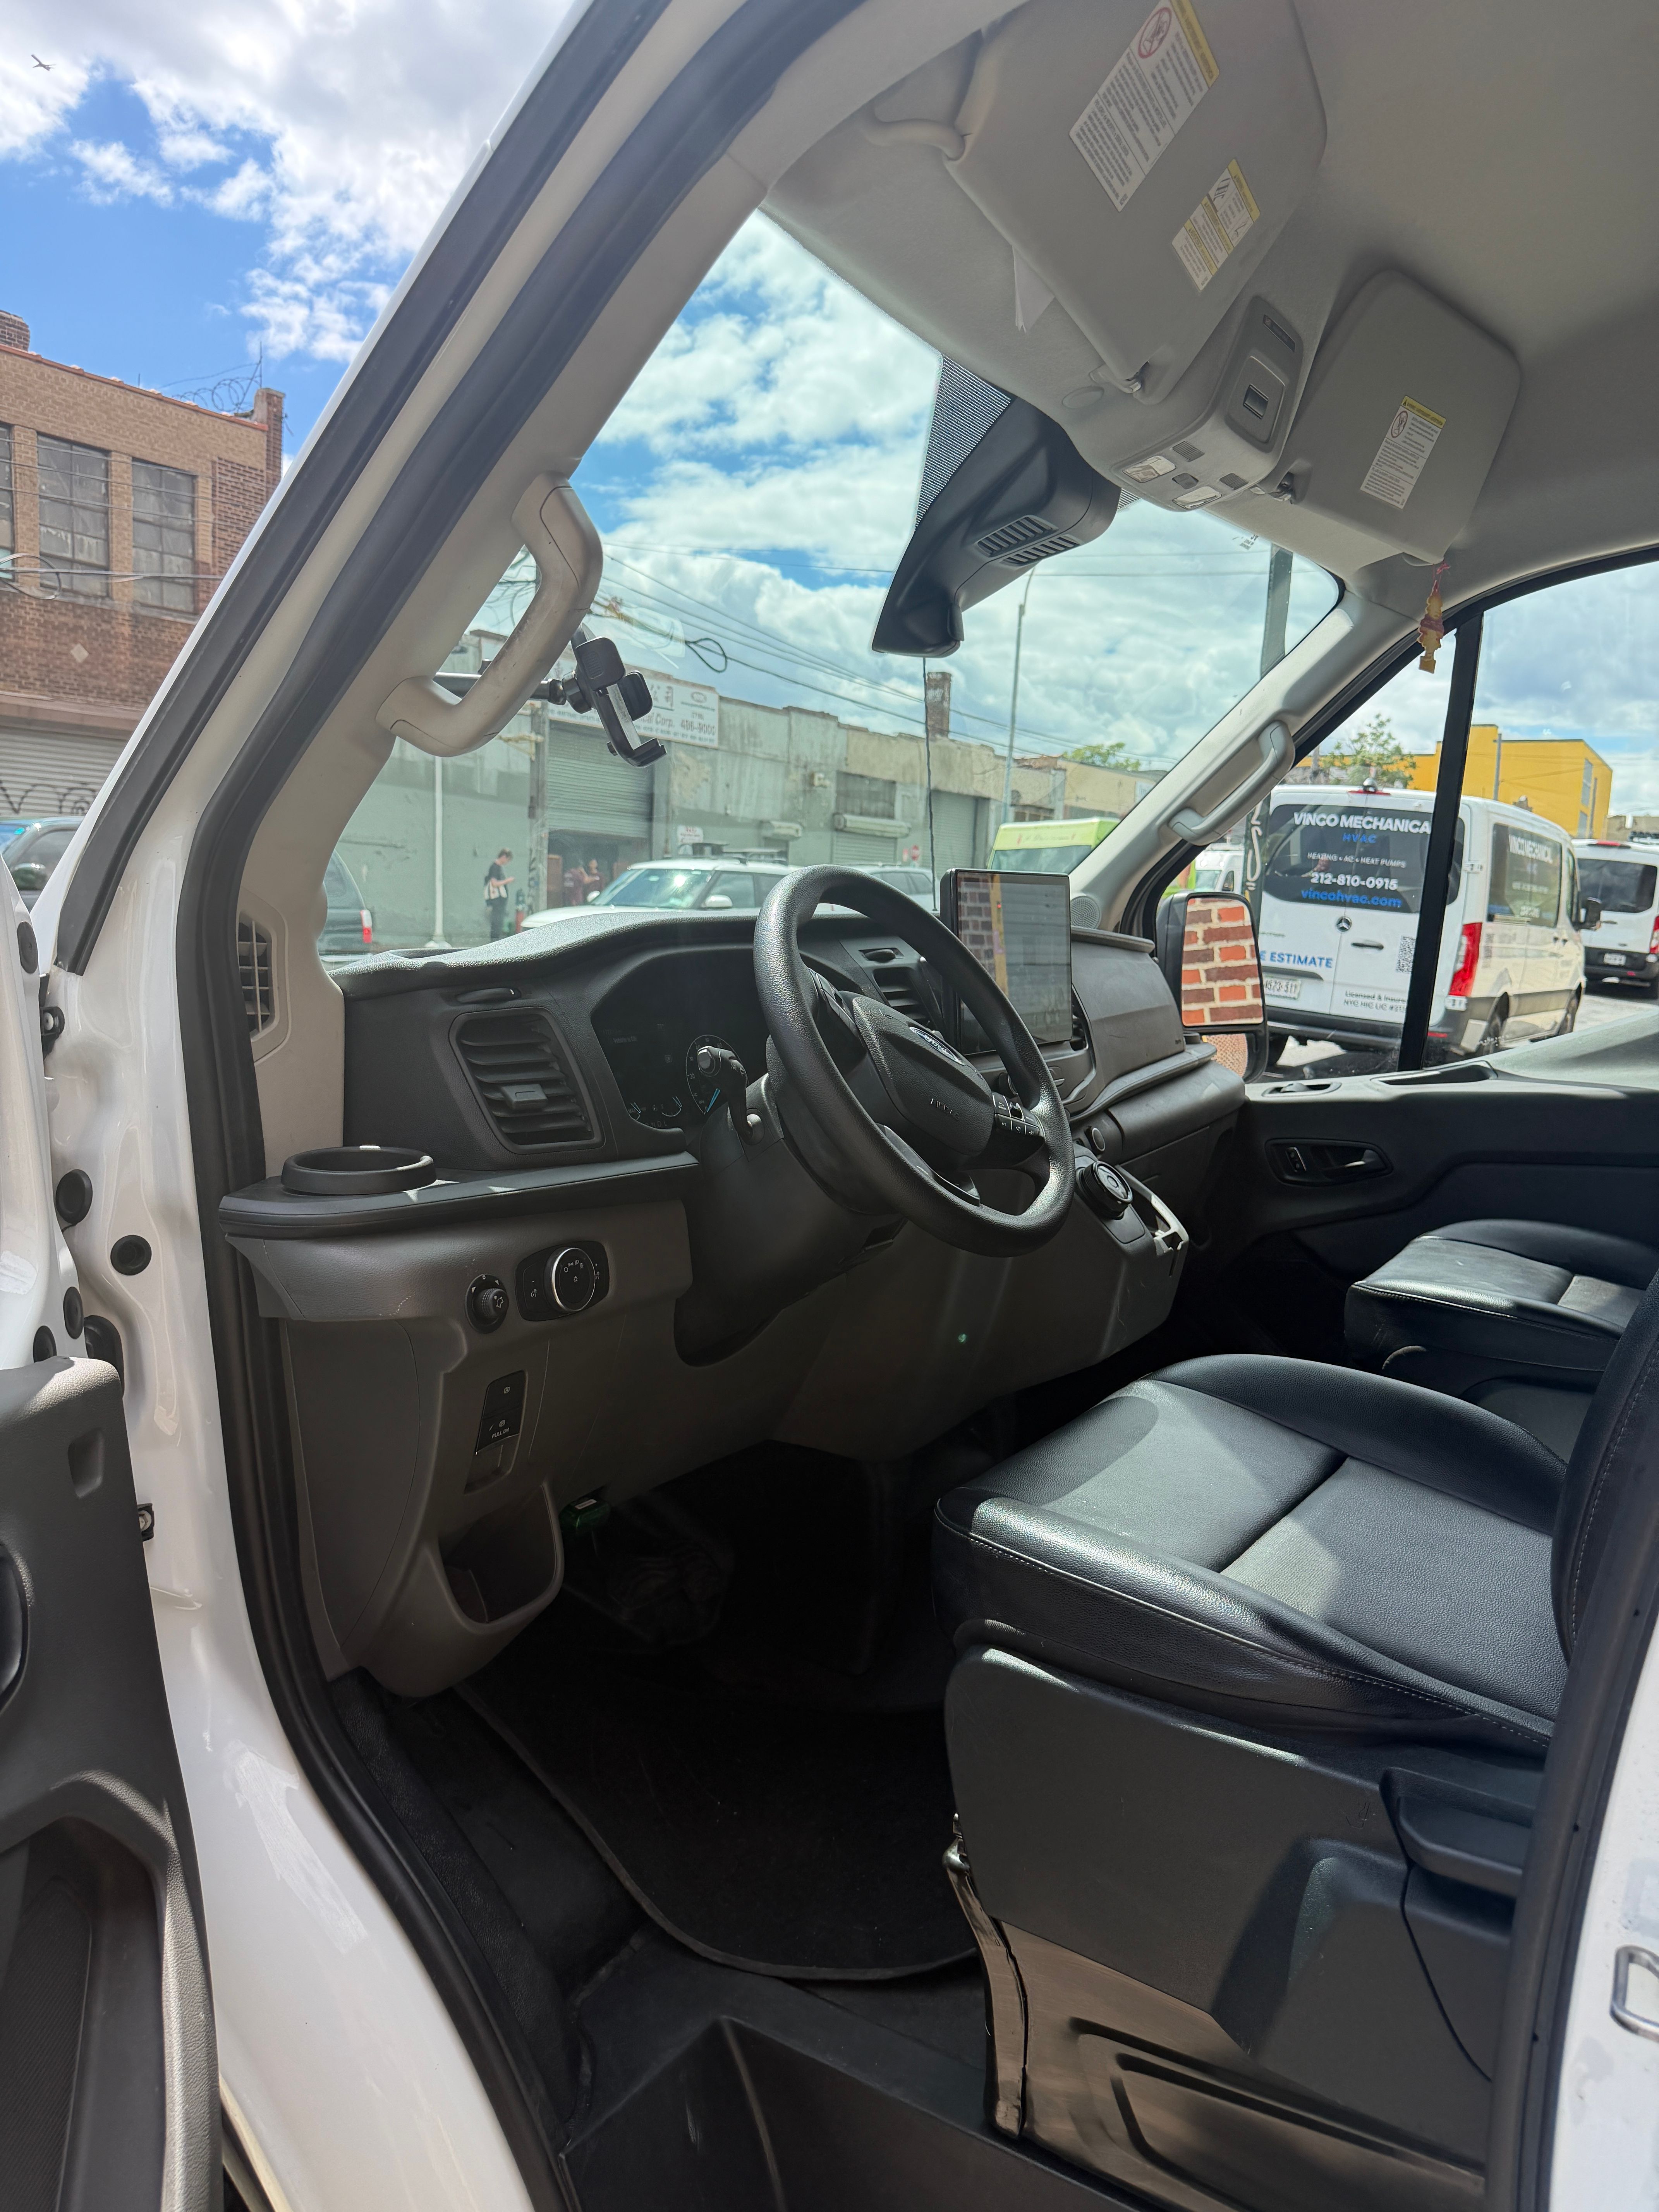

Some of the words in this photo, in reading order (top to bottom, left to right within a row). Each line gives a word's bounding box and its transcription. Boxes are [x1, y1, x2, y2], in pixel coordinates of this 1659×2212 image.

[656, 713, 675, 728] Corp.
[1294, 812, 1339, 827] VINCO
[1340, 814, 1431, 834] MECHANICA
[1342, 833, 1377, 843] HVAC
[1307, 852, 1338, 861] HEATING
[1360, 856, 1380, 865] HEAT
[1380, 858, 1407, 868] PUMPS
[1311, 872, 1398, 890] 212-810-0915
[1301, 888, 1402, 908] vincohvac.com
[1270, 951, 1333, 969] ESTIMATE
[1344, 999, 1359, 1007] NYC
[1360, 1001, 1374, 1009] HIC
[1345, 990, 1376, 1000] Licensed
[1384, 994, 1407, 1003] Insure
